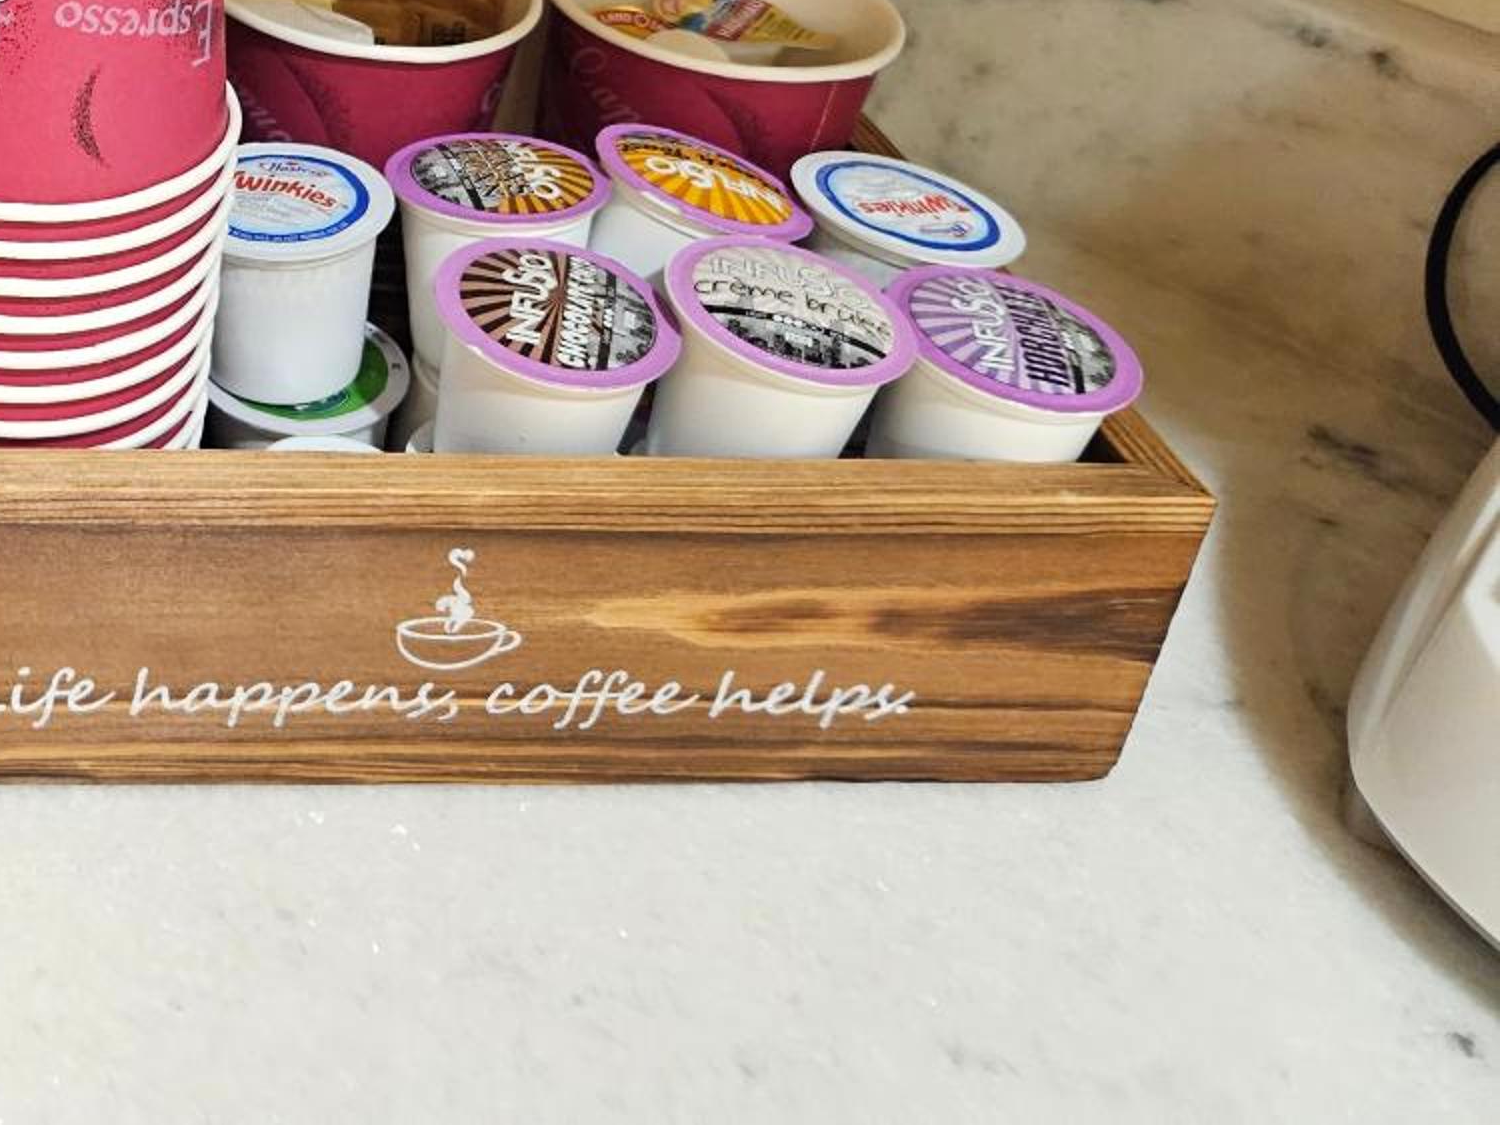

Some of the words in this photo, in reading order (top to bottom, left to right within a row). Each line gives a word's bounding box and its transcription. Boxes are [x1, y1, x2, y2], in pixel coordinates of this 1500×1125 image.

[129, 667, 460, 728] happens,
[486, 668, 698, 730] coffee
[711, 669, 912, 729] helps.
